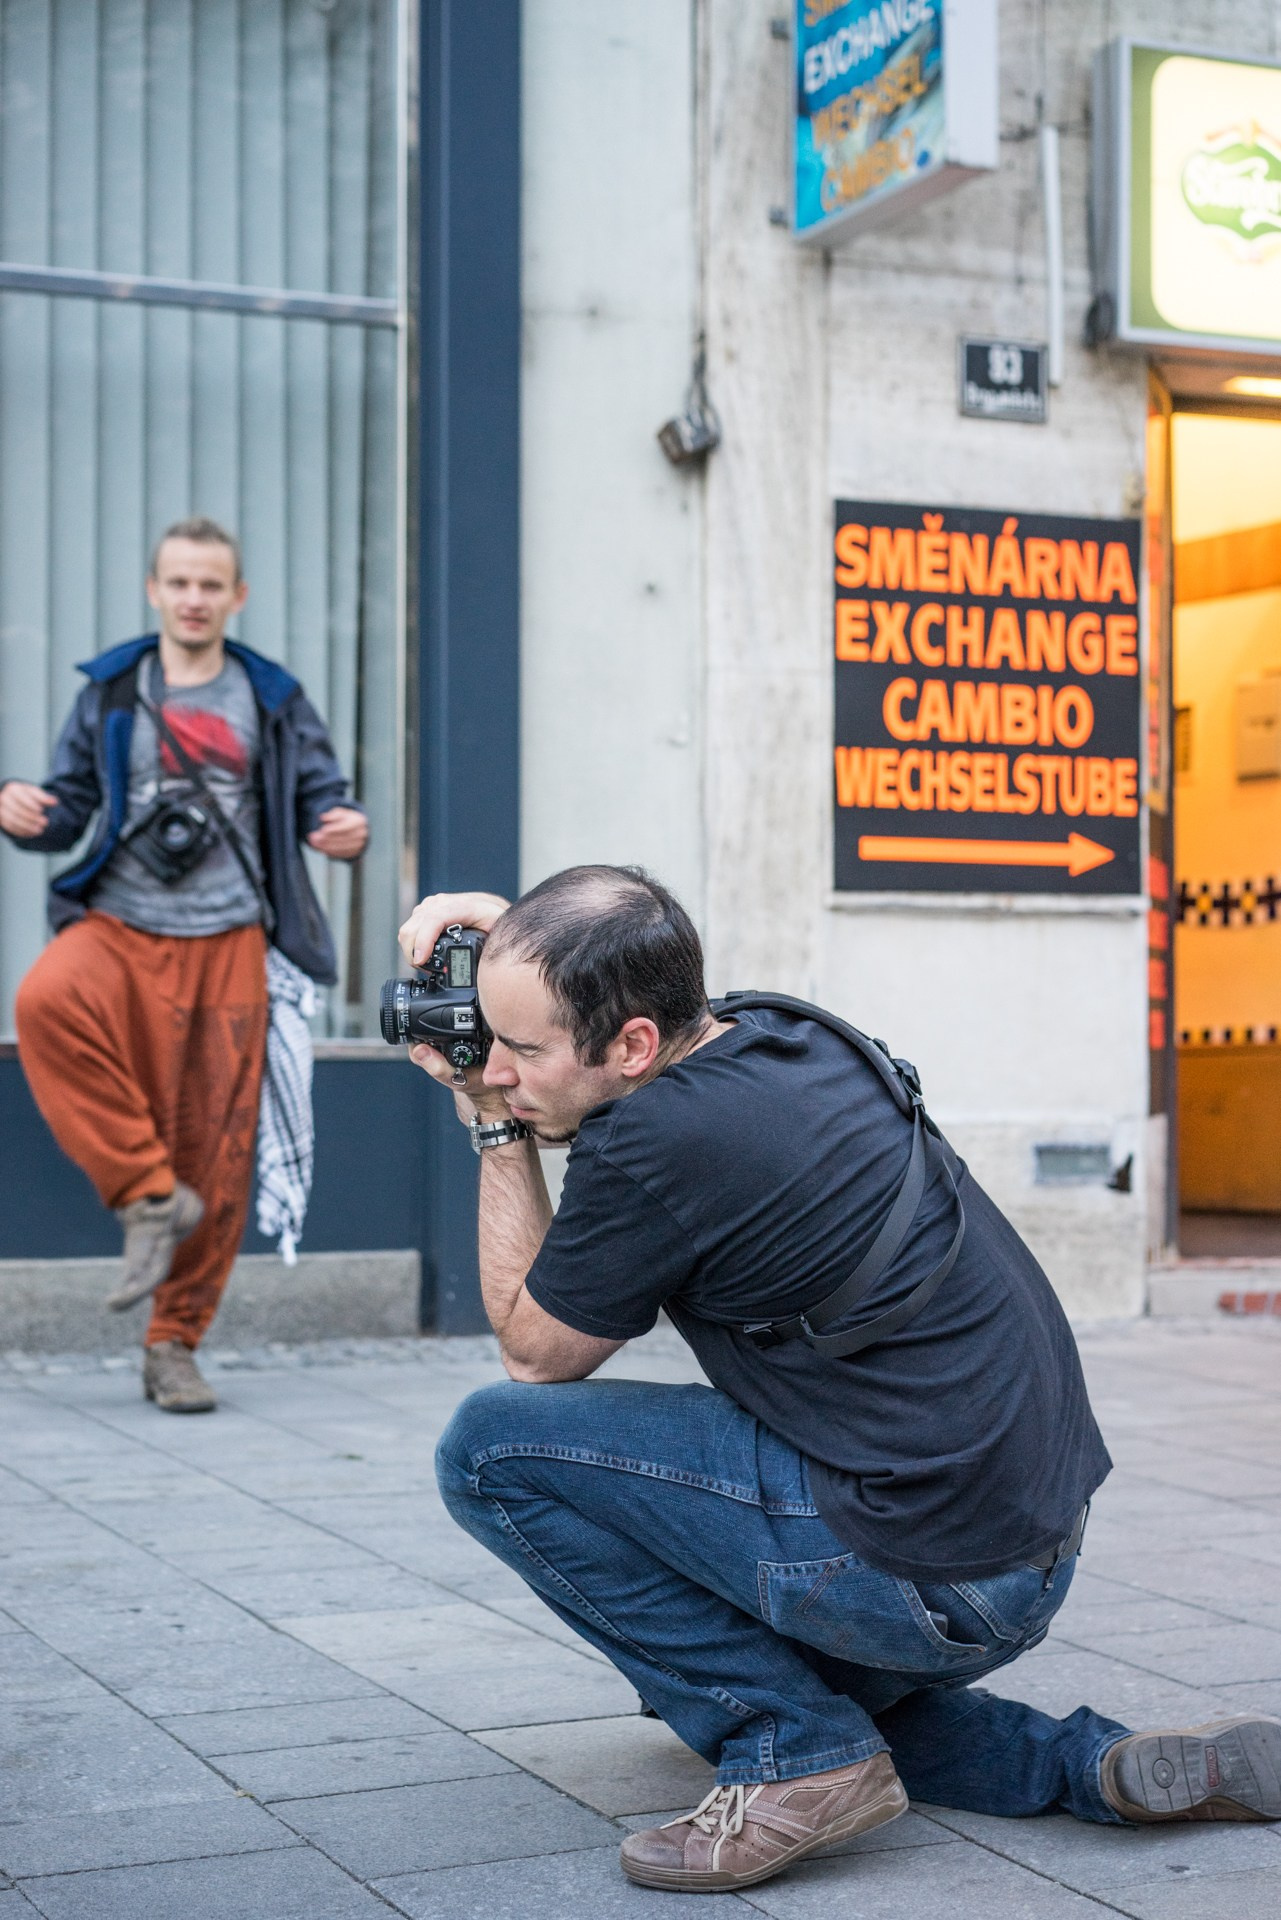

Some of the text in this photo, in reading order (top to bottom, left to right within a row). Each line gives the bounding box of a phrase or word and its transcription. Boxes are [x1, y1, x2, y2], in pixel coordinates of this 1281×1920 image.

[821, 127, 914, 212] CAMBIO
[834, 512, 1137, 605] SMĚNÁRNA
[835, 598, 1138, 676] EXCHANGE
[882, 677, 1094, 749] CAMBIO
[835, 746, 1138, 818] WECHSELSTUBE
